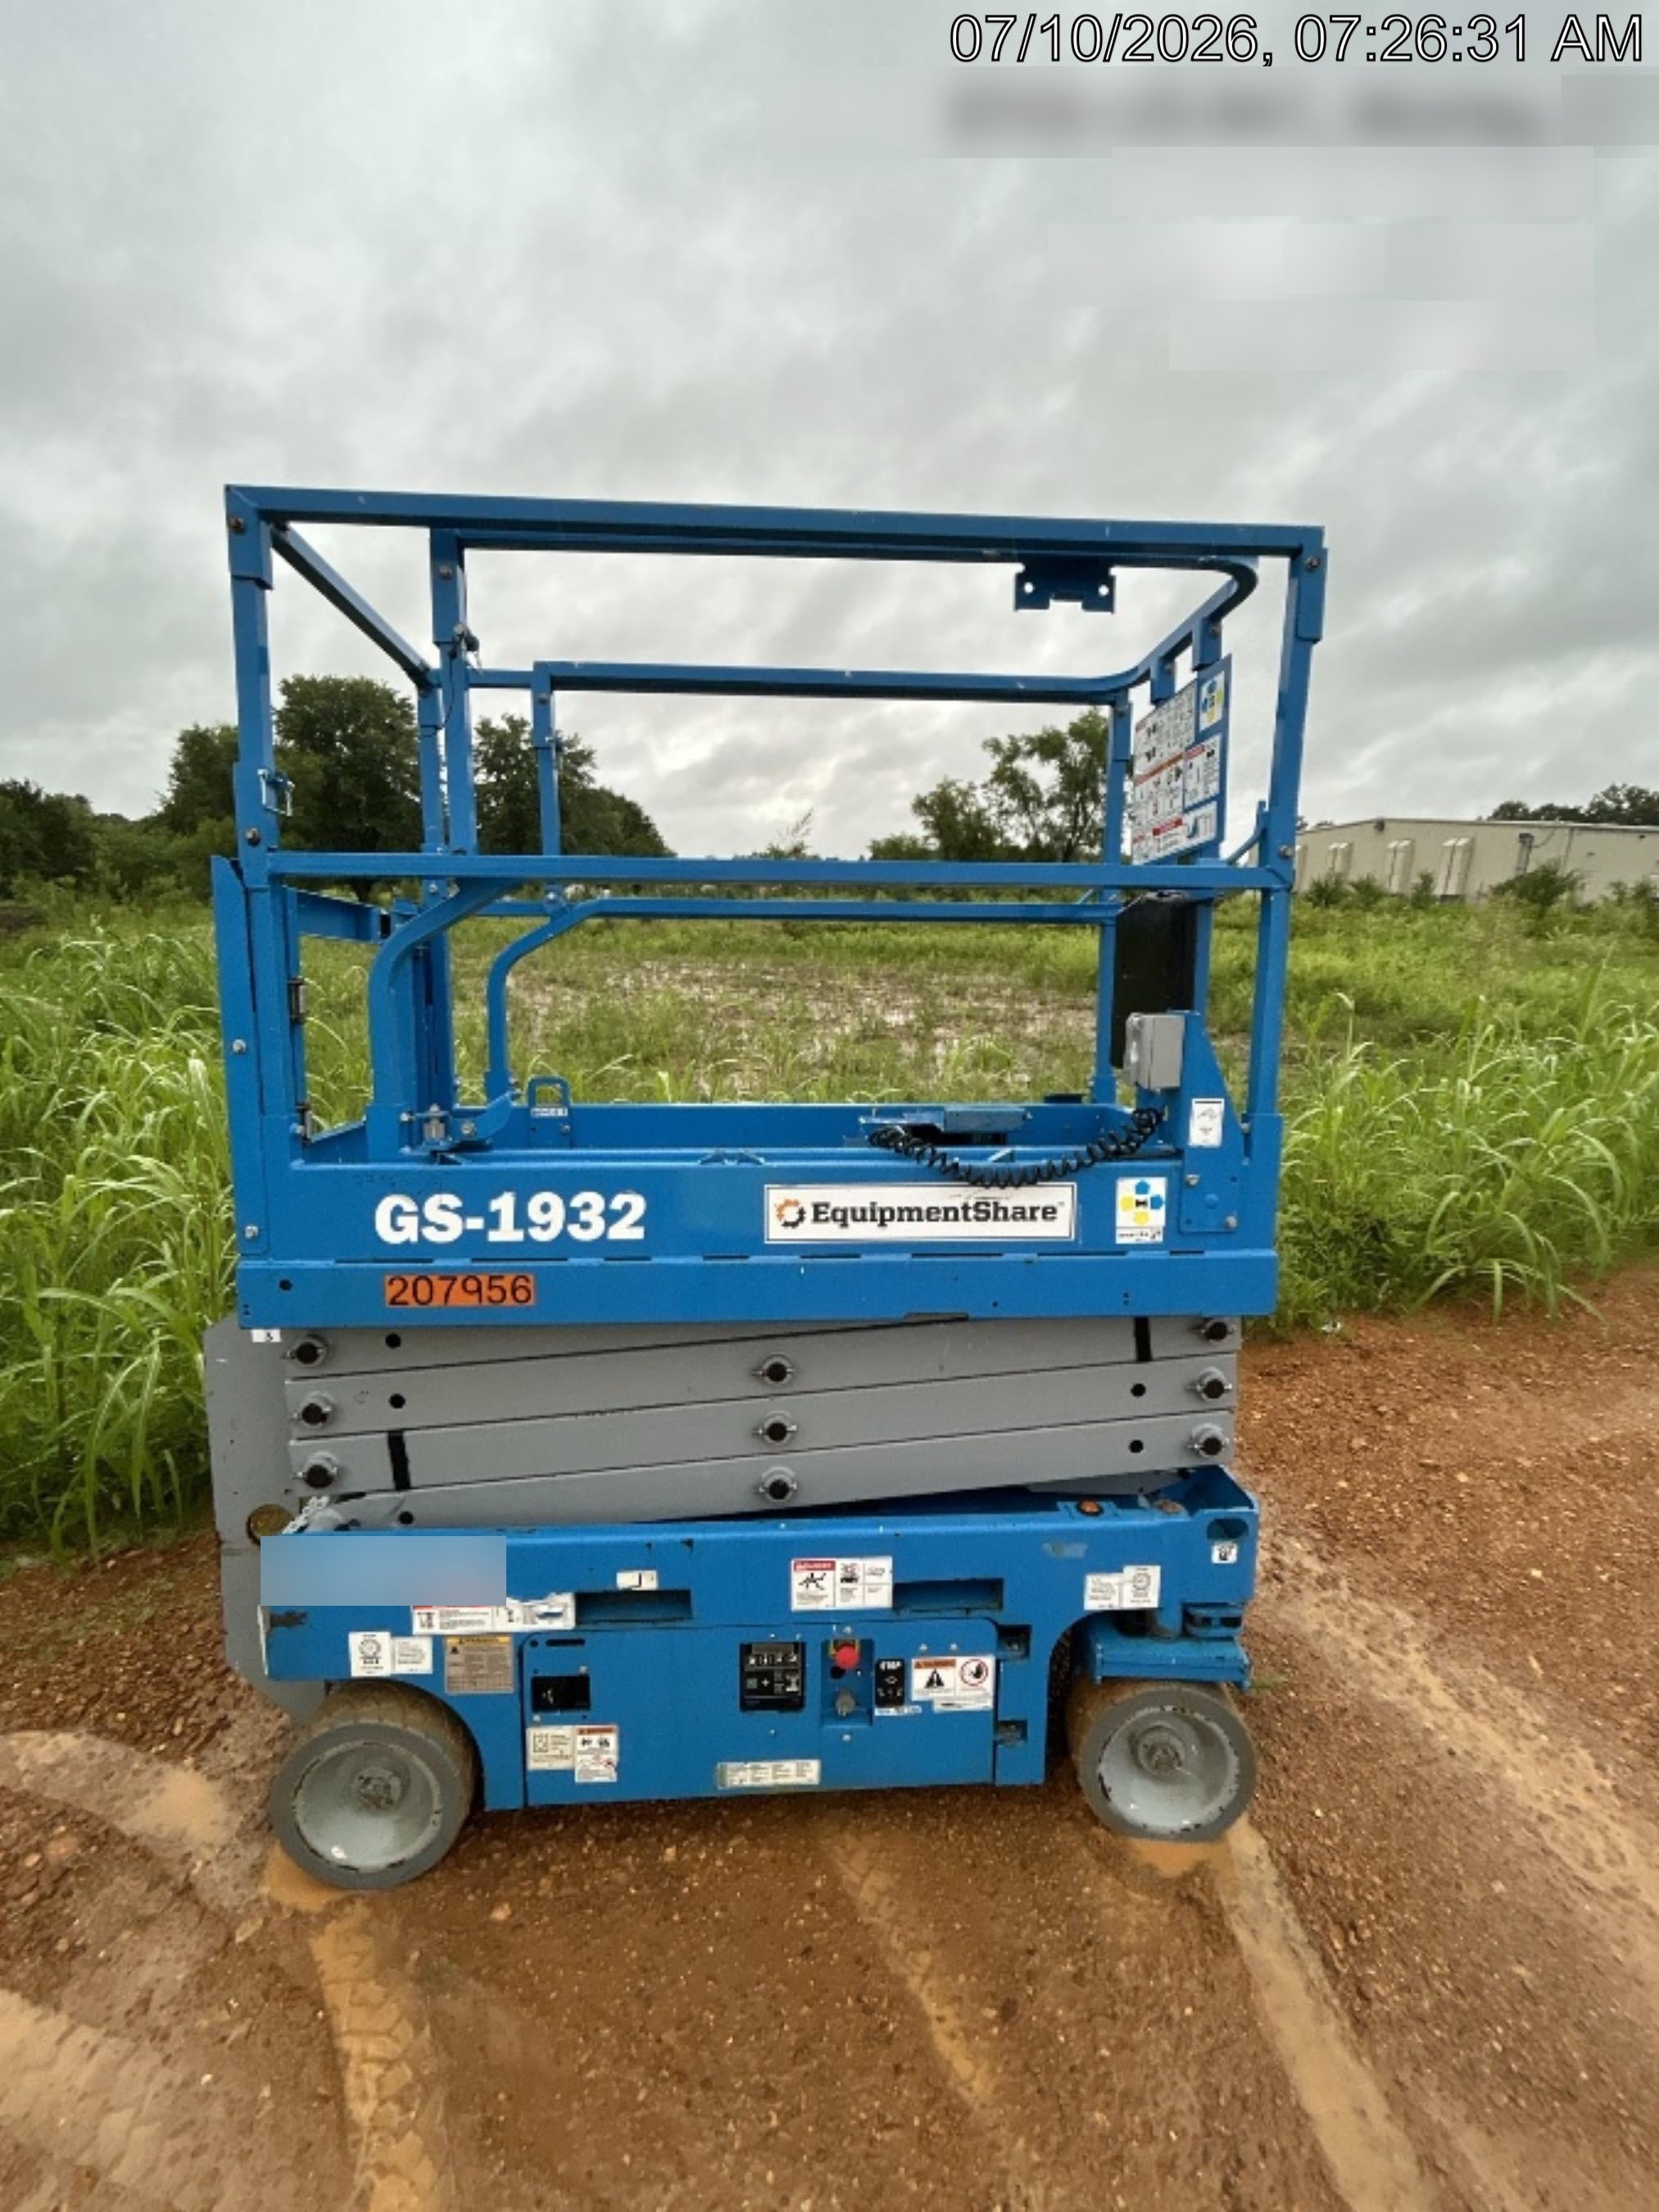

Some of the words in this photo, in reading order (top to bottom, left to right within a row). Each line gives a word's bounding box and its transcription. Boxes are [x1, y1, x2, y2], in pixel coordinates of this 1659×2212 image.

[374, 1191, 646, 1244] GS-1932
[813, 1201, 1058, 1228] EquipmentShare
[388, 1275, 533, 1306] 207956
